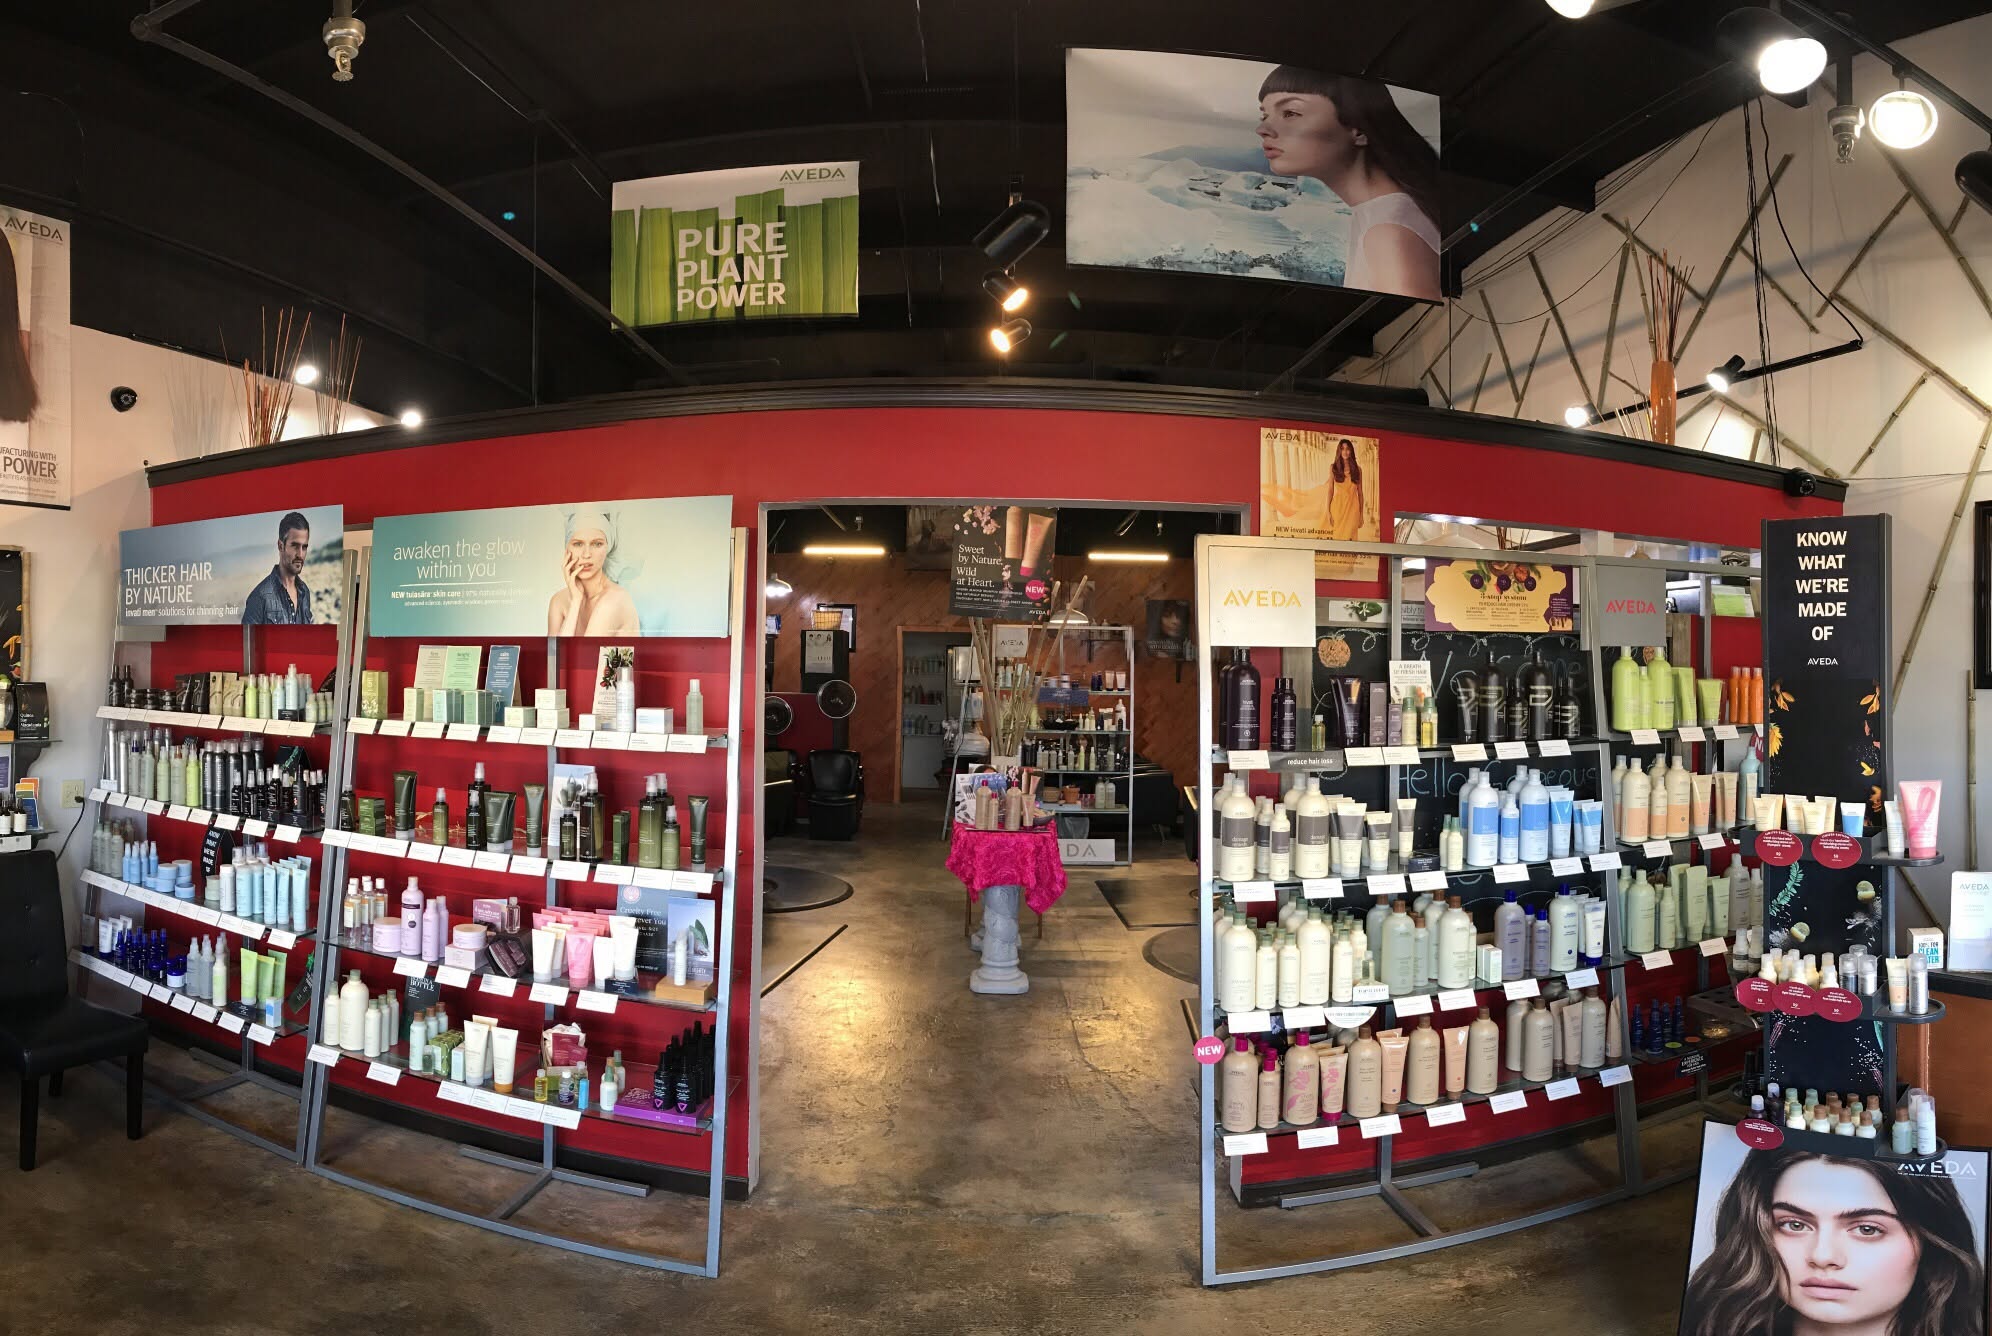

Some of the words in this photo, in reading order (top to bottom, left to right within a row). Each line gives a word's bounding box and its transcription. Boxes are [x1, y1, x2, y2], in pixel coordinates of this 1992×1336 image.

[779, 167, 846, 182] AVEDA
[5, 217, 63, 241] AVEDA
[678, 222, 787, 259] PURE
[677, 253, 789, 287] PLANT
[677, 282, 786, 312] POWER
[1265, 432, 1299, 441] AVEDA
[40, 452, 57, 461] WITH
[3, 456, 57, 478] POWER
[1307, 527, 1334, 535] advanced
[1796, 530, 1848, 548] KNOW
[393, 540, 450, 560] awaken
[456, 538, 481, 557] the
[486, 536, 526, 560] glow
[958, 544, 985, 555] Sweet
[958, 554, 968, 565] by
[971, 554, 1003, 566] Nature.
[1798, 554, 1846, 571] WHAT
[124, 565, 176, 585] THICKER
[180, 562, 212, 582] HAIR
[416, 560, 462, 580] within
[467, 561, 496, 582] you
[956, 567, 977, 577] Wild
[967, 578, 995, 588] Heart.
[1025, 585, 1045, 594] NEW
[1795, 578, 1849, 594] WE'RE
[125, 588, 140, 605] BY
[144, 585, 193, 604] NATURE
[391, 591, 404, 599] NEW
[1223, 589, 1302, 608] AVEDA
[158, 606, 186, 617] solutions
[186, 606, 195, 616] for
[196, 605, 224, 617] thinning
[224, 604, 239, 615] hair
[1606, 599, 1656, 614] AVEDA
[1798, 602, 1847, 618] MADE
[1811, 626, 1834, 641] OF
[1807, 657, 1839, 666] AVEDA
[1308, 757, 1320, 765] hair
[620, 906, 646, 916] Cruelty
[646, 908, 662, 917] Free
[654, 918, 667, 926] You
[1918, 947, 1939, 956] CLEAN
[1197, 1044, 1222, 1056] NEW
[1897, 1160, 1977, 1177] AVEDA
